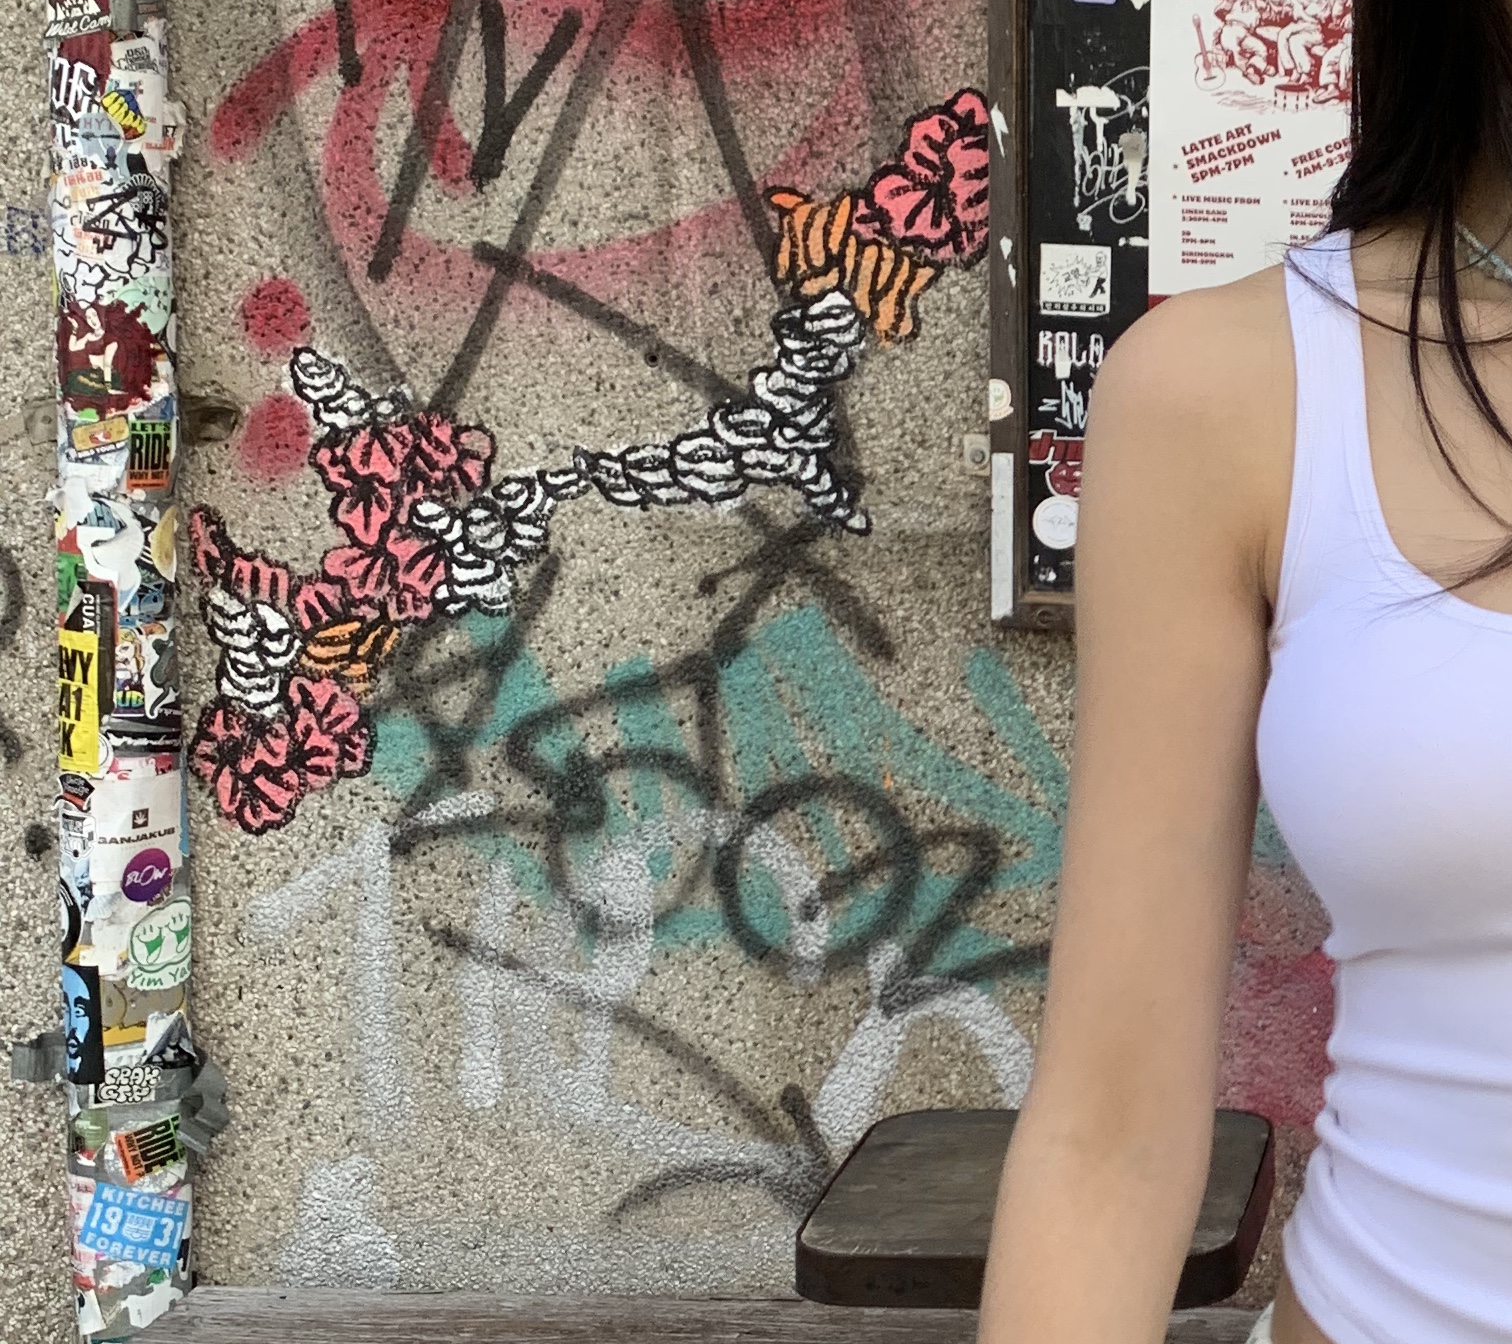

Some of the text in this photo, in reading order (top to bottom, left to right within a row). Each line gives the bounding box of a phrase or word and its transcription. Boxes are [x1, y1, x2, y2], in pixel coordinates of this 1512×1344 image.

[1181, 123, 1253, 157] LATTE ART
[1186, 128, 1282, 170] SMACKDOWN
[1190, 153, 1255, 184] 5PM-7PM
[1290, 147, 1323, 167] FREE
[1181, 194, 1261, 205] LIVE MUSIC FROM
[1290, 198, 1311, 206] LIVE
[101, 1186, 185, 1217] KITCHEE
[89, 1202, 184, 1250] 19 31
[84, 1232, 173, 1266] FOREVER
